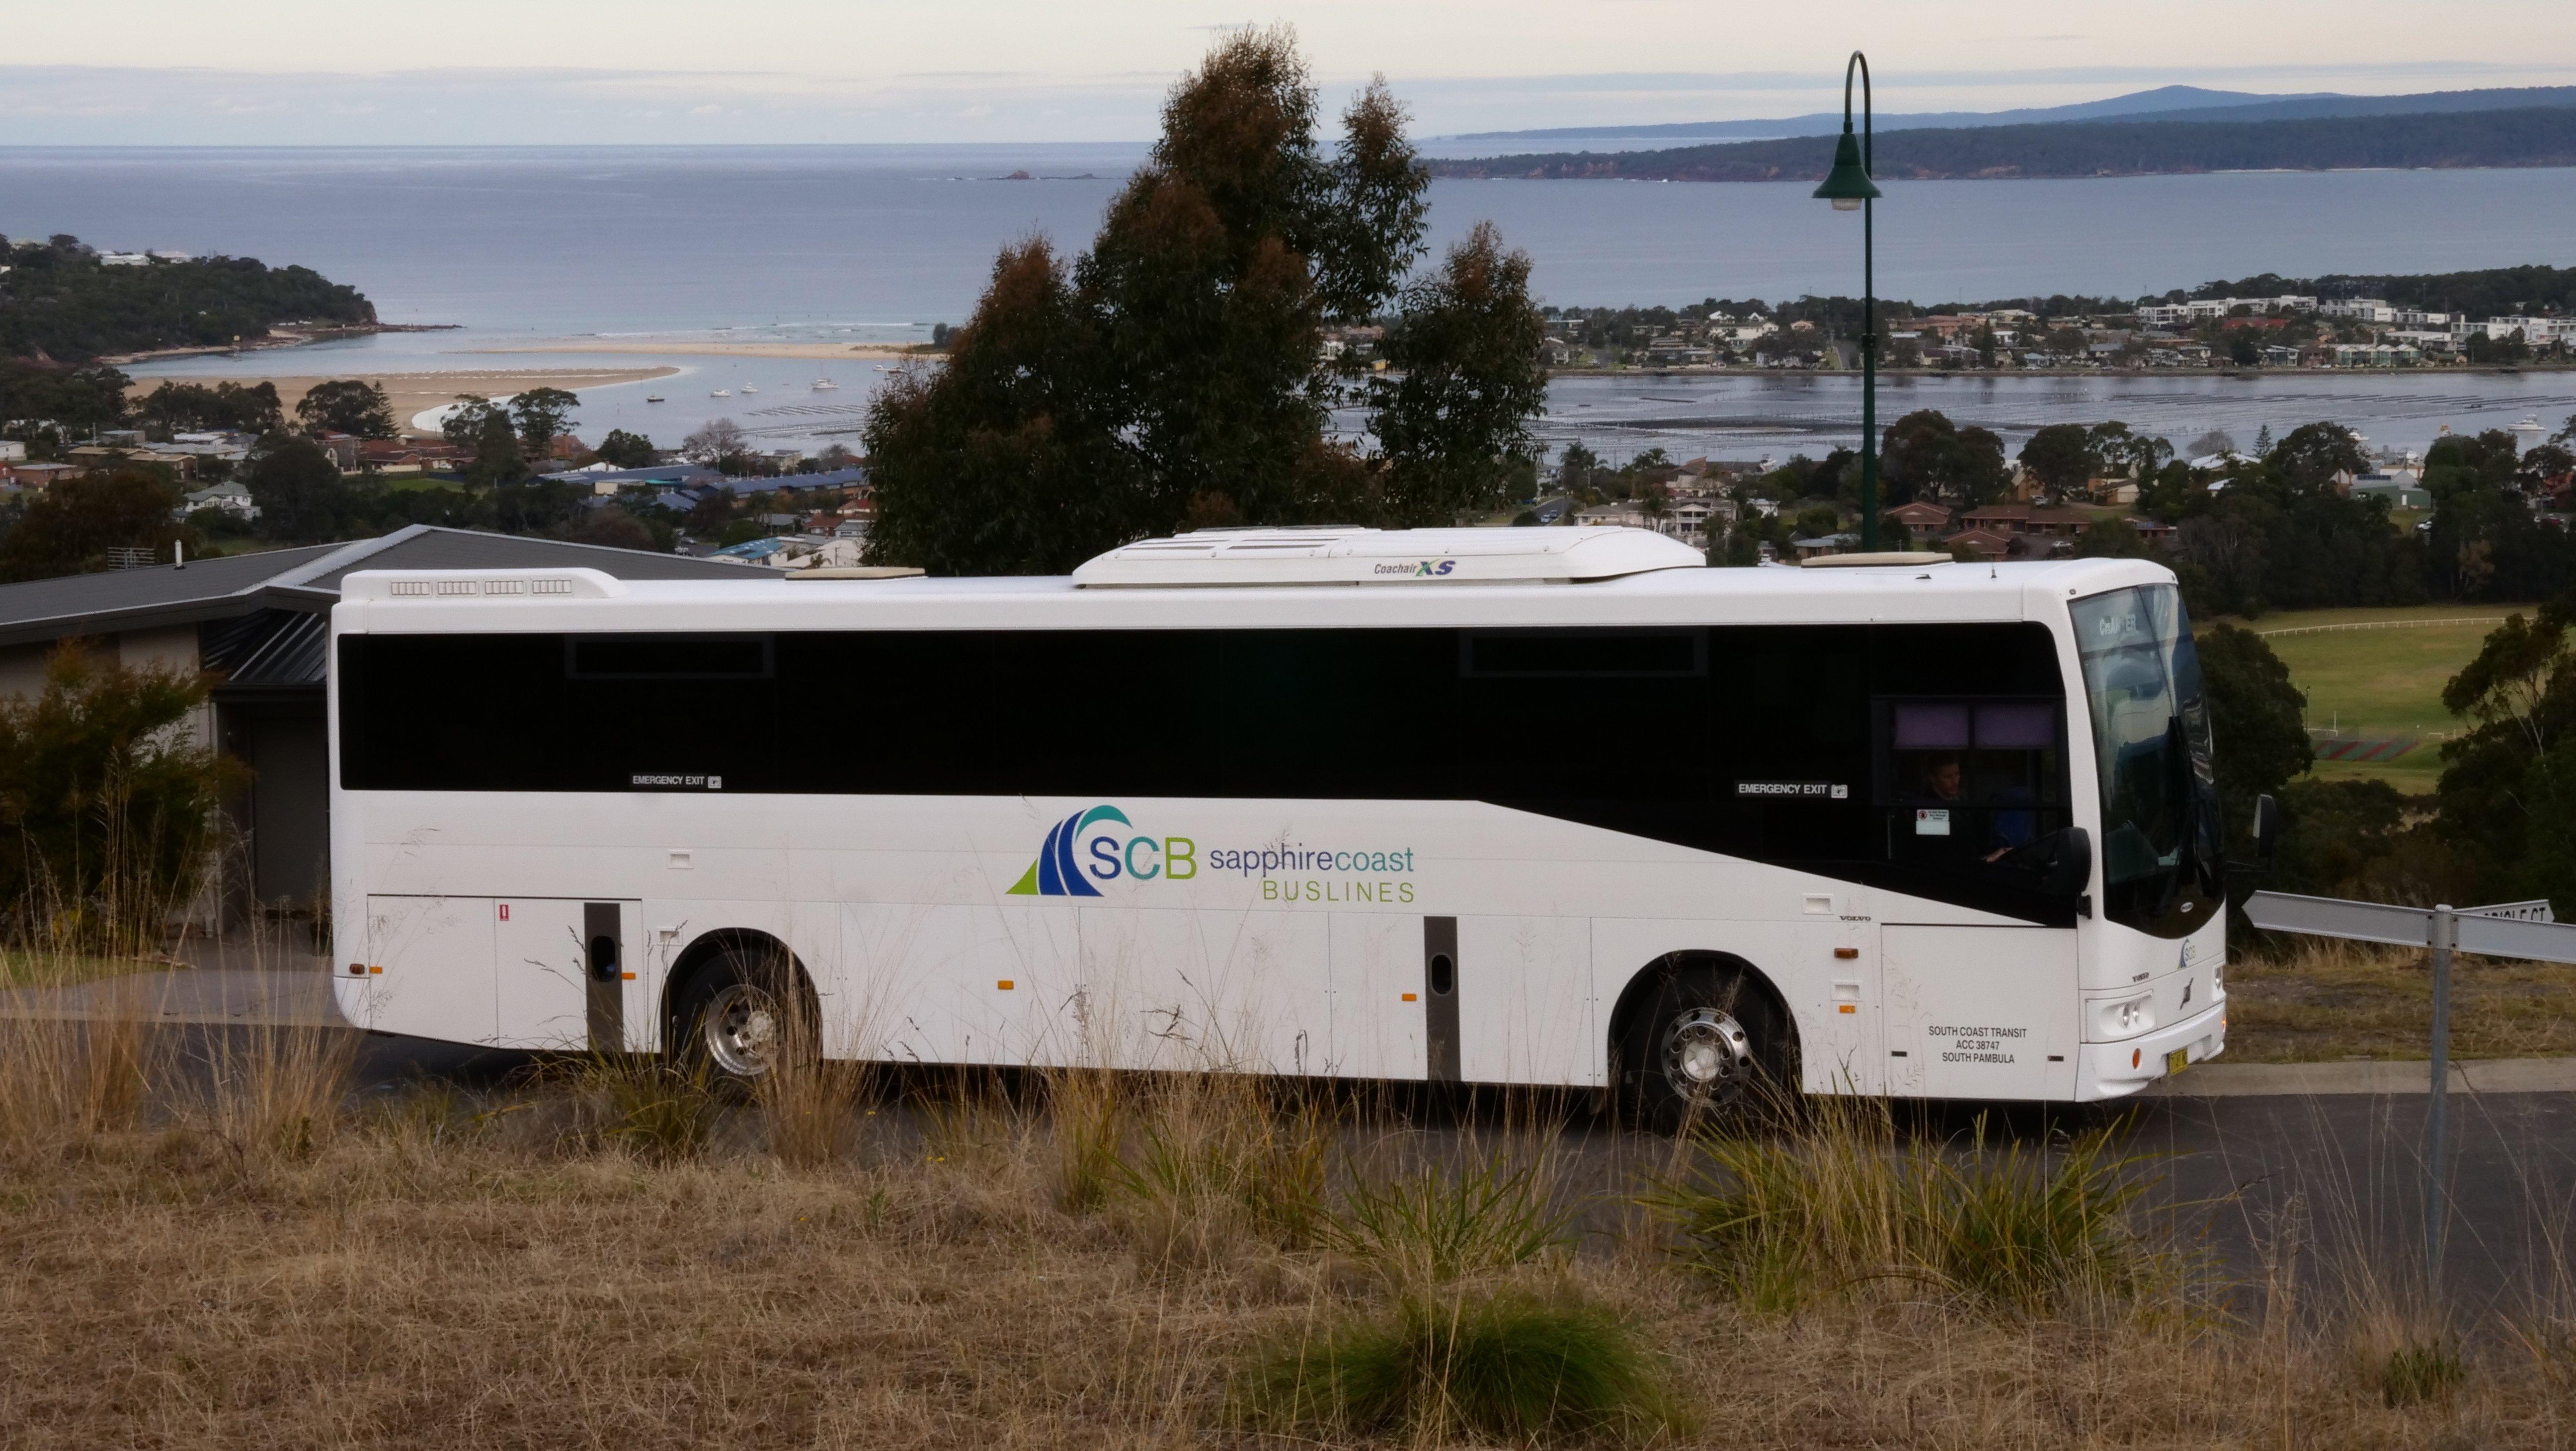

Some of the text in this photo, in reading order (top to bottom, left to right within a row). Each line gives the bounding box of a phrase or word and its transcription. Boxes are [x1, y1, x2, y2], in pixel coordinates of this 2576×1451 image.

[1374, 559, 1456, 576] Coachair XS
[633, 775, 705, 785] EMERGENCY EXIT
[1739, 784, 1827, 794] EMERGENCY EXIT
[1089, 836, 1197, 881] SCB
[1209, 843, 1414, 878] sapphirecoast
[1263, 881, 1414, 903] BUSLINES
[1929, 1026, 2027, 1038] SOUTH COAST TRANSIT
[1956, 1040, 2000, 1050] ACC 38747
[1942, 1052, 2015, 1063] SOUTH PAMBULA
